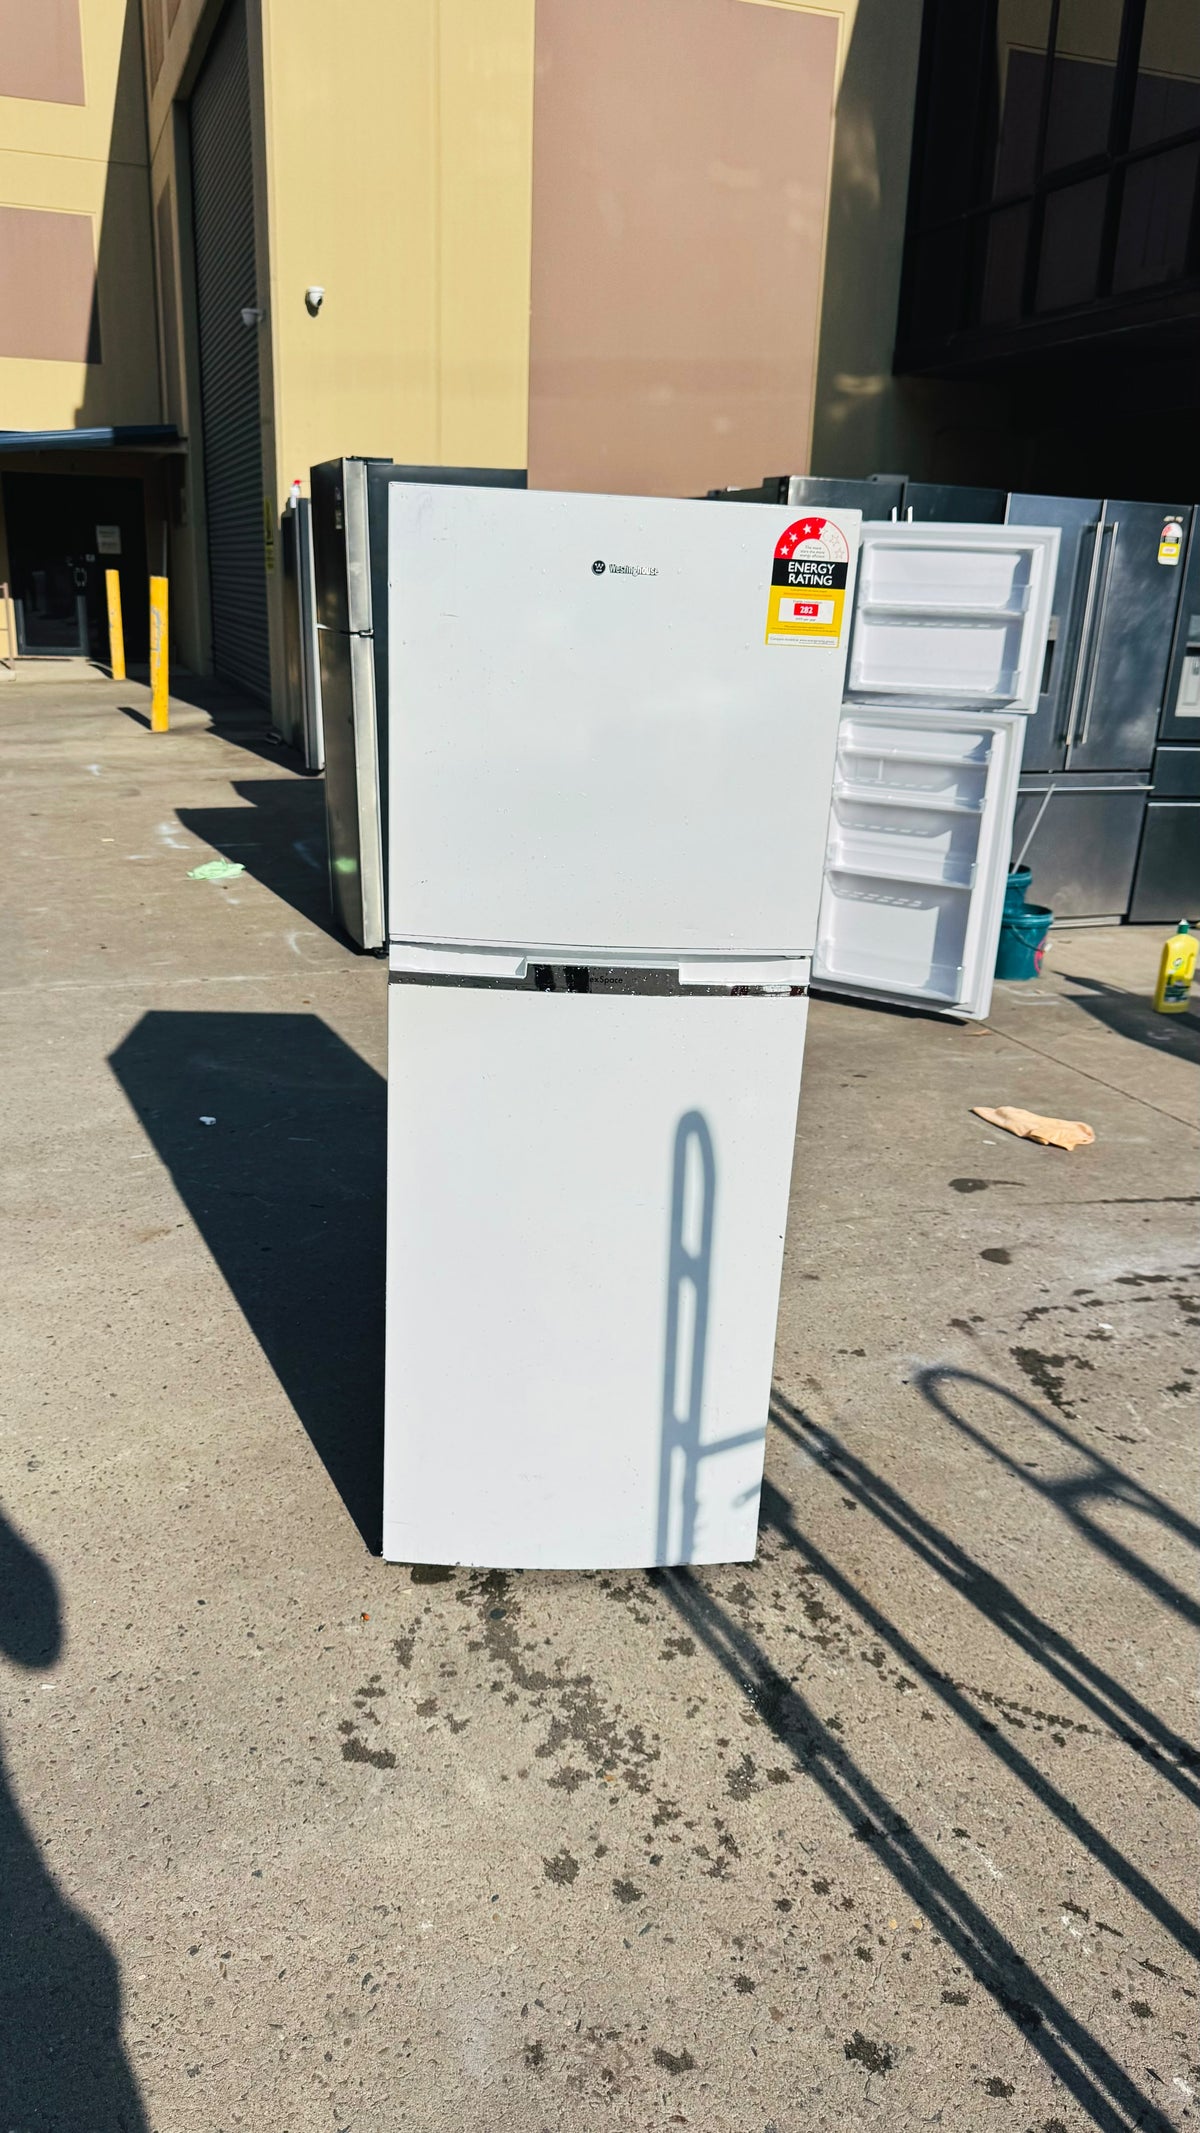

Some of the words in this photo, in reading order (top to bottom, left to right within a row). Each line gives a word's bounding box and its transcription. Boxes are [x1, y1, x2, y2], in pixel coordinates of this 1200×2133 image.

[787, 561, 836, 575] ENERGY
[589, 575, 624, 585] exSpace
[787, 573, 833, 586] RATING
[800, 606, 813, 614] 282
